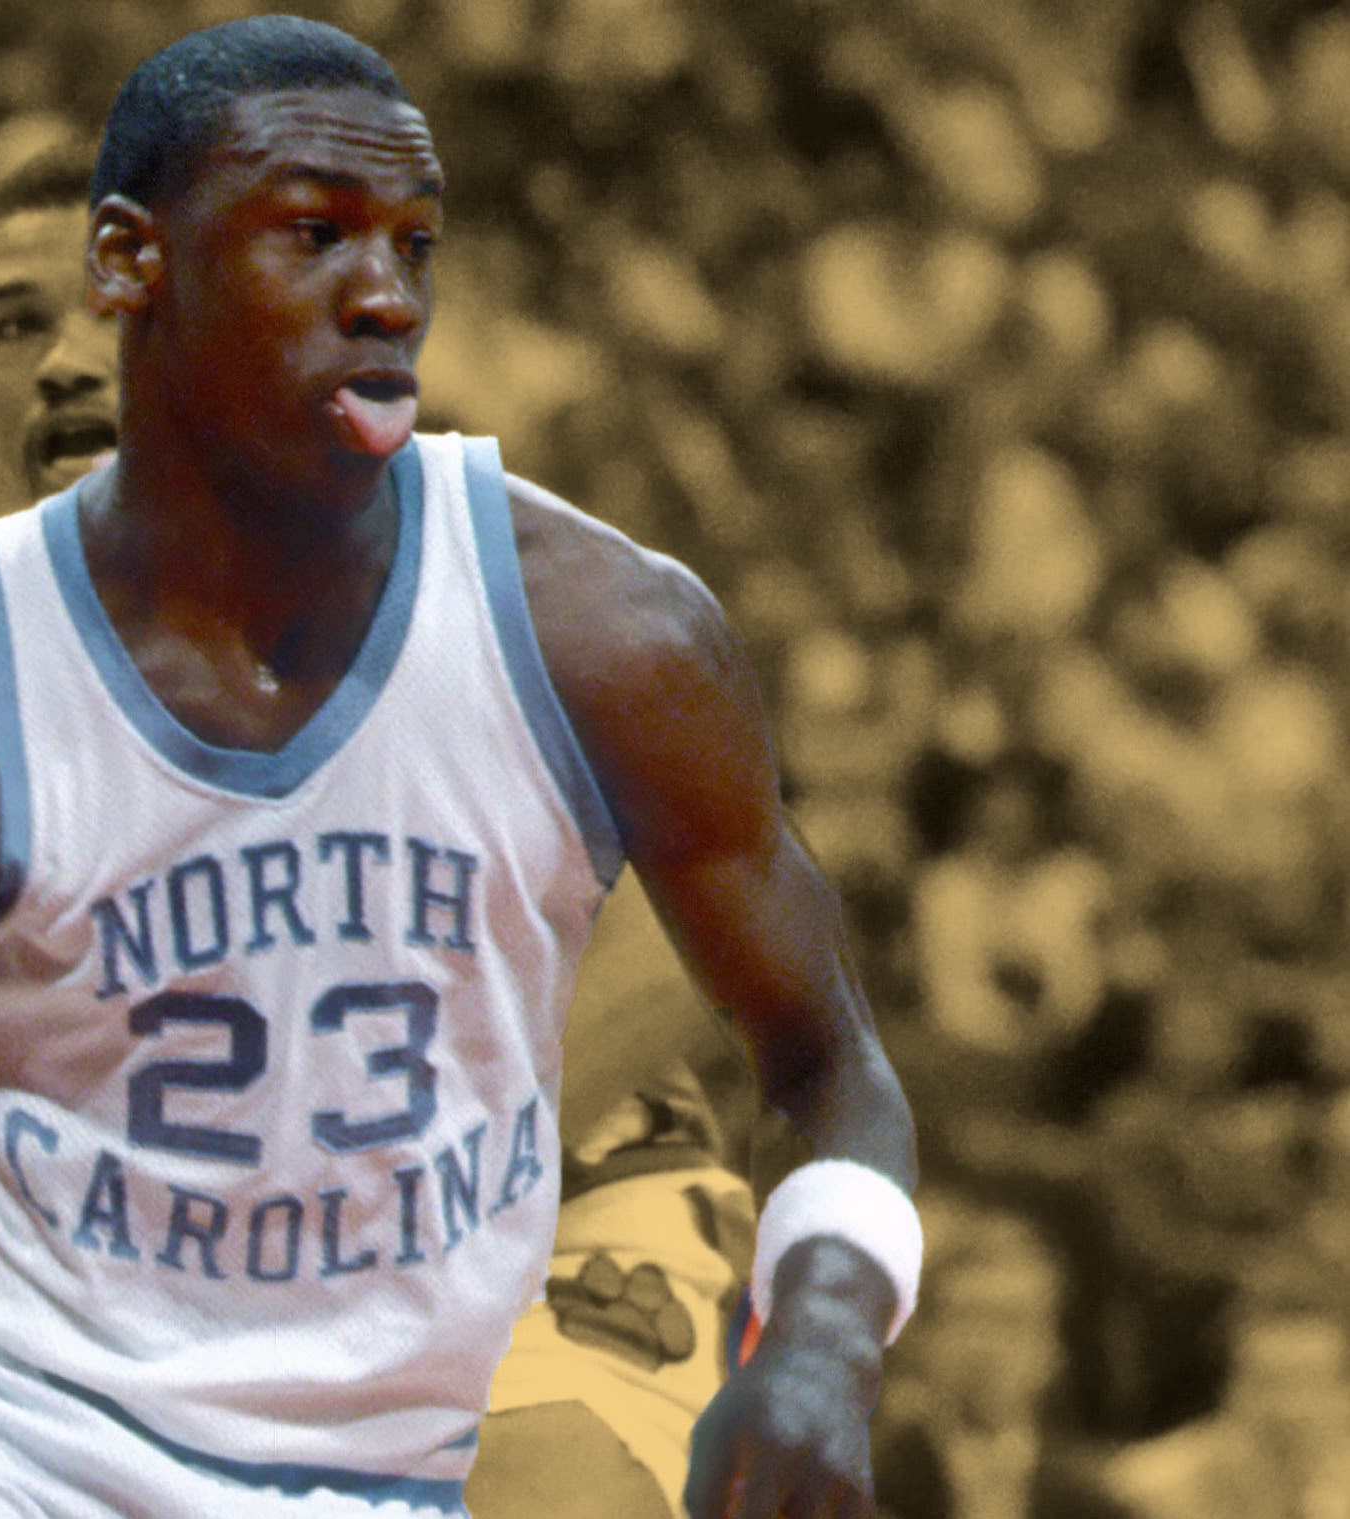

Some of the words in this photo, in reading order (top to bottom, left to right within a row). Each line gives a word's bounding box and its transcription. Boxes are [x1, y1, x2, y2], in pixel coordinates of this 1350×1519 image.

[88, 830, 479, 1001] NORTH
[126, 980, 440, 1167] 23
[3, 1094, 544, 1284] CAROLINA
